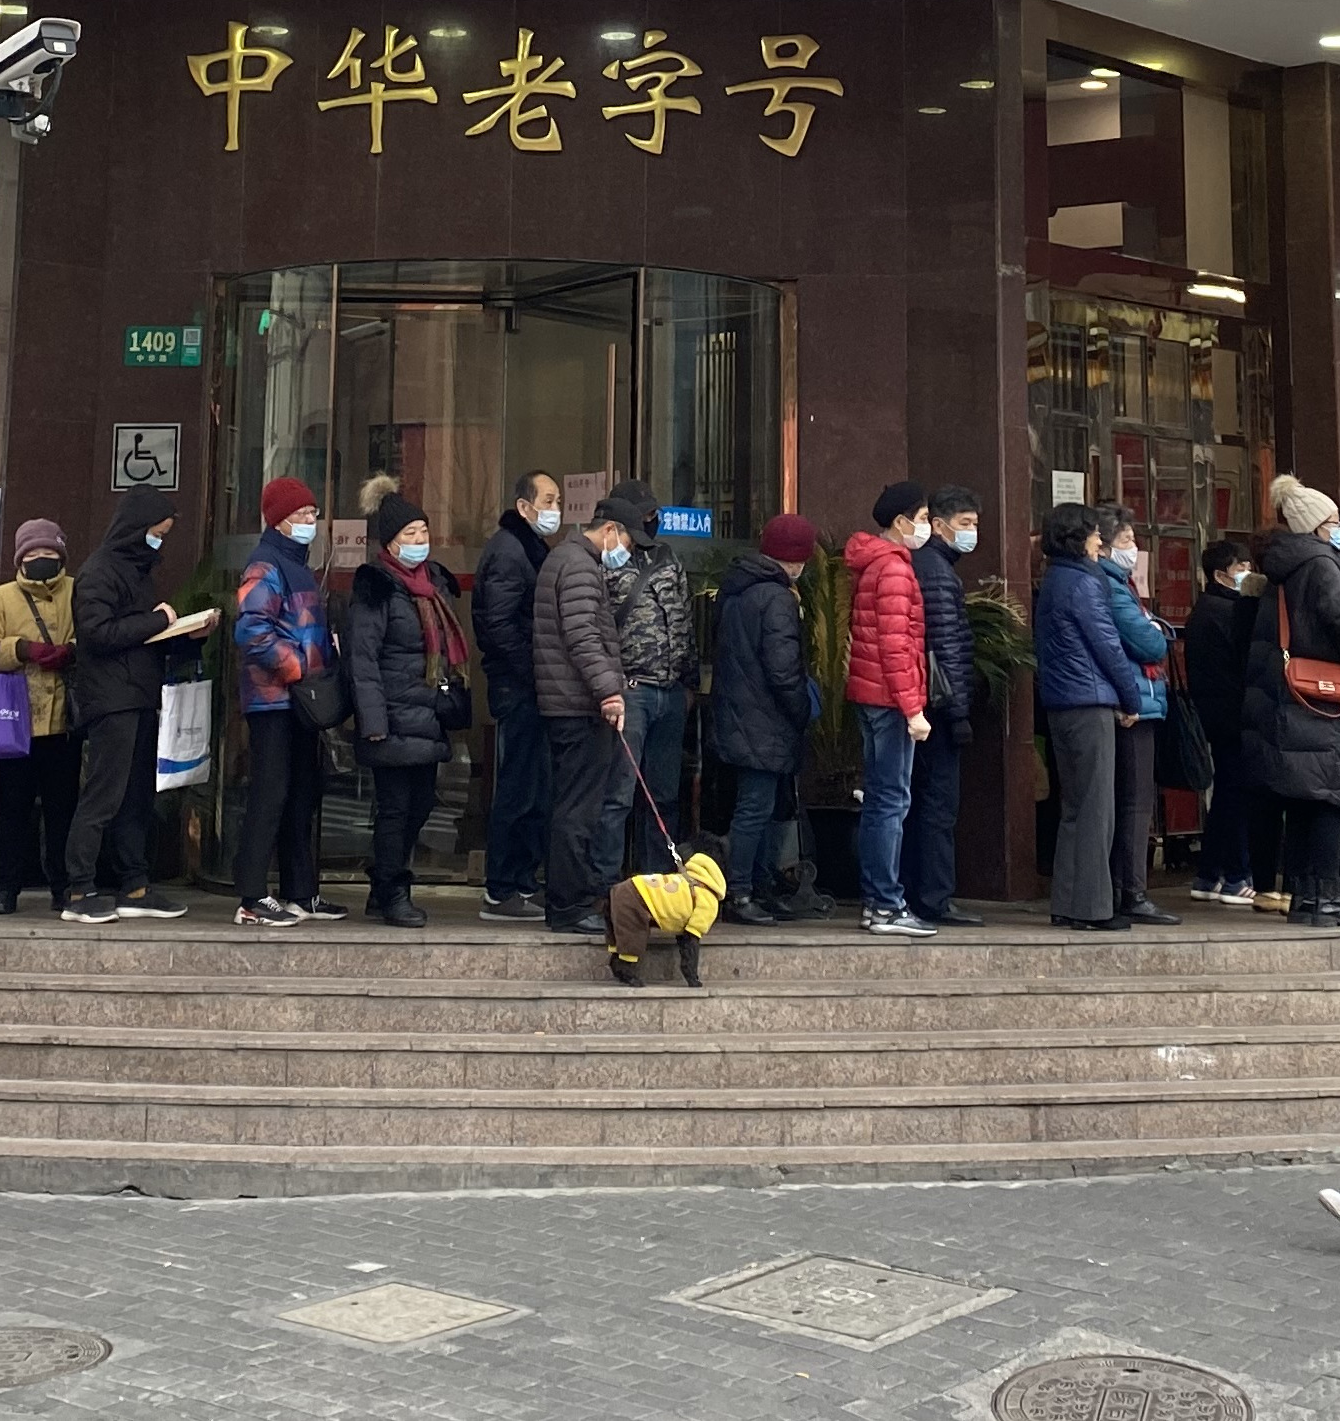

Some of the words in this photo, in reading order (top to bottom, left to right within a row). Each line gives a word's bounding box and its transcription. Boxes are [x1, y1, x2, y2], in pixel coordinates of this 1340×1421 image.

[187, 21, 845, 157] 中华老字号
[129, 331, 176, 352] 1409
[663, 511, 711, 533] 宠物禁止入内
